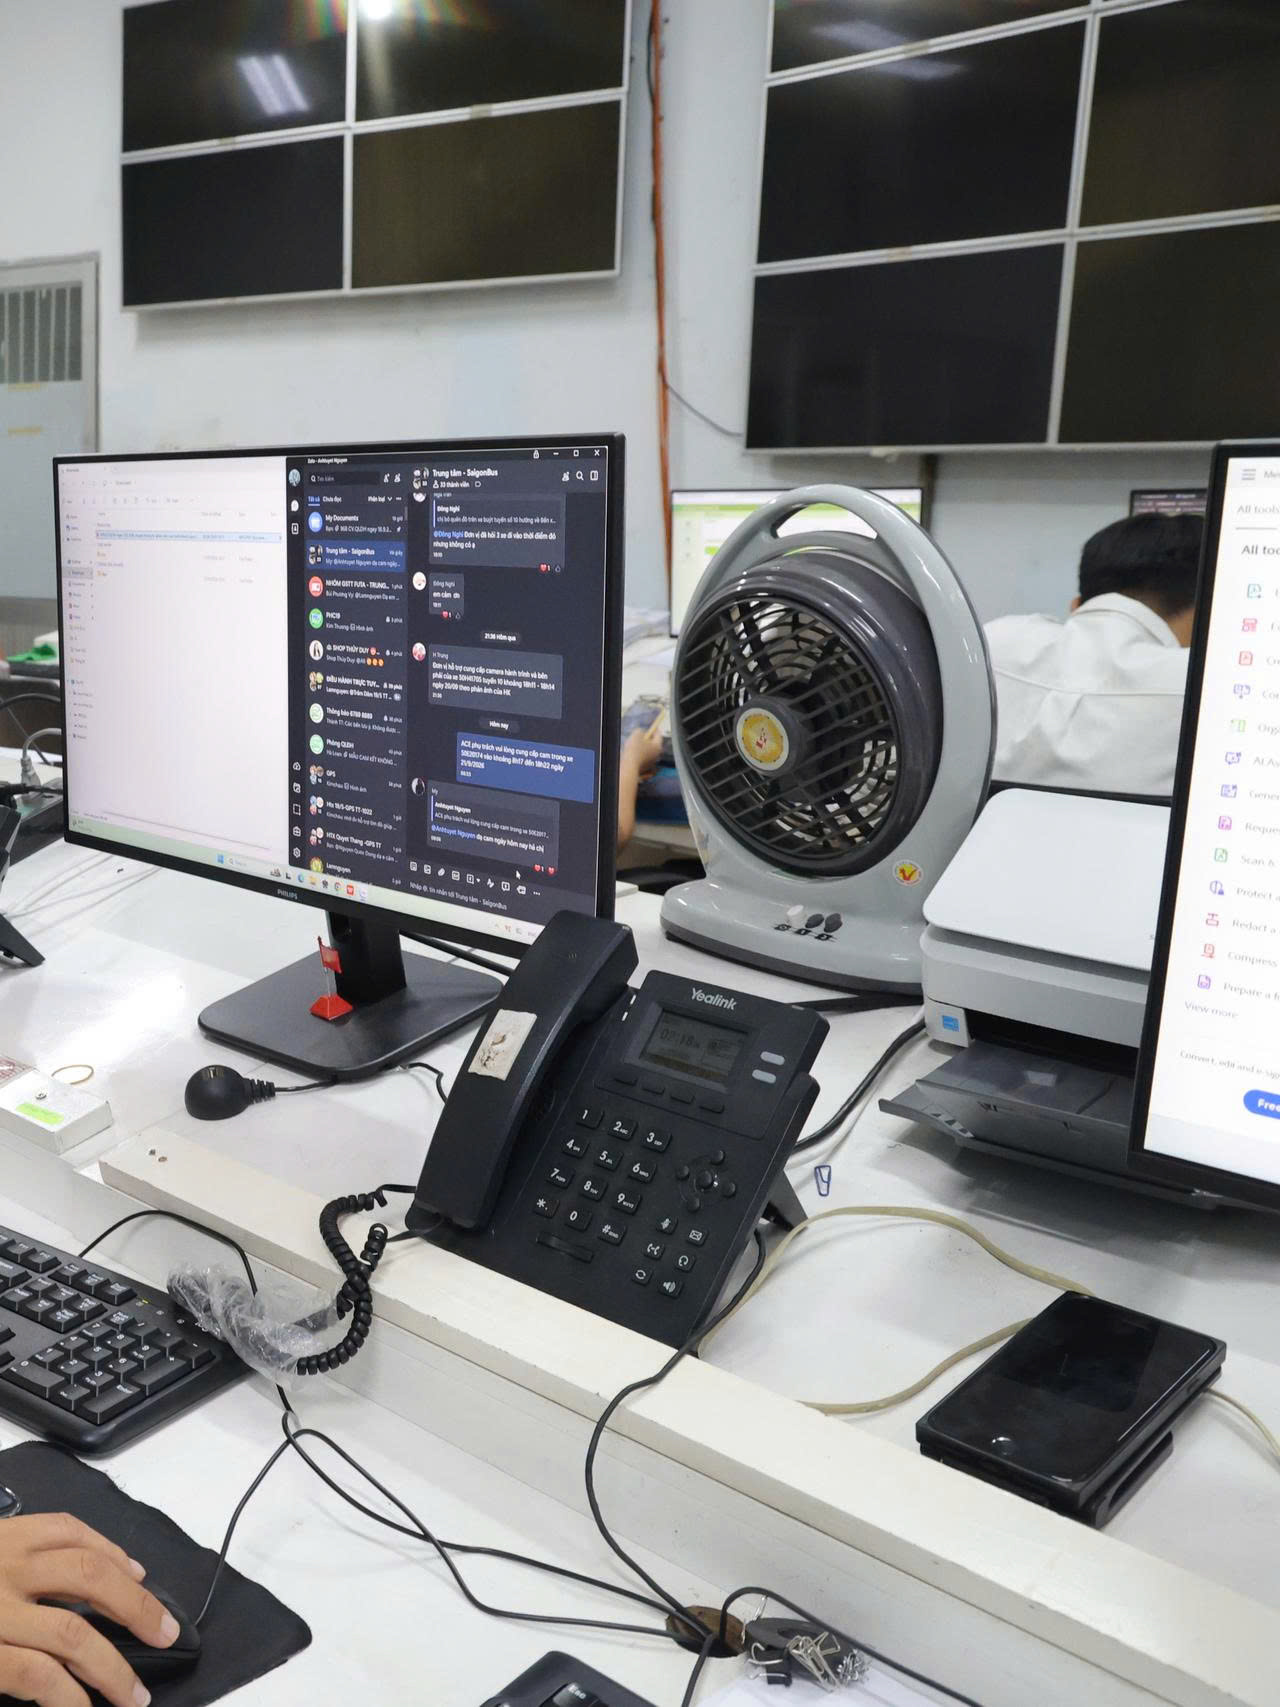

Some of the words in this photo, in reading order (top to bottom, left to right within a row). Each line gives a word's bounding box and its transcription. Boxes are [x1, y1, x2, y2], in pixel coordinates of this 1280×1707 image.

[432, 469, 449, 479] Trung
[450, 468, 462, 477] tâm
[466, 467, 499, 479] SaigonBus
[333, 514, 359, 522] Documents
[1241, 545, 1258, 555] All
[486, 668, 505, 676] camera
[690, 986, 737, 1012] Yealink
[582, 1109, 589, 1120] 1
[612, 1121, 623, 1132] 2
[646, 1132, 655, 1143] 3
[566, 1139, 576, 1150] 4
[599, 1150, 608, 1161] 5
[550, 1167, 560, 1178] 7
[632, 1162, 641, 1173] 6
[583, 1180, 593, 1191] 8
[617, 1192, 626, 1203] 9
[569, 1210, 578, 1222] 0
